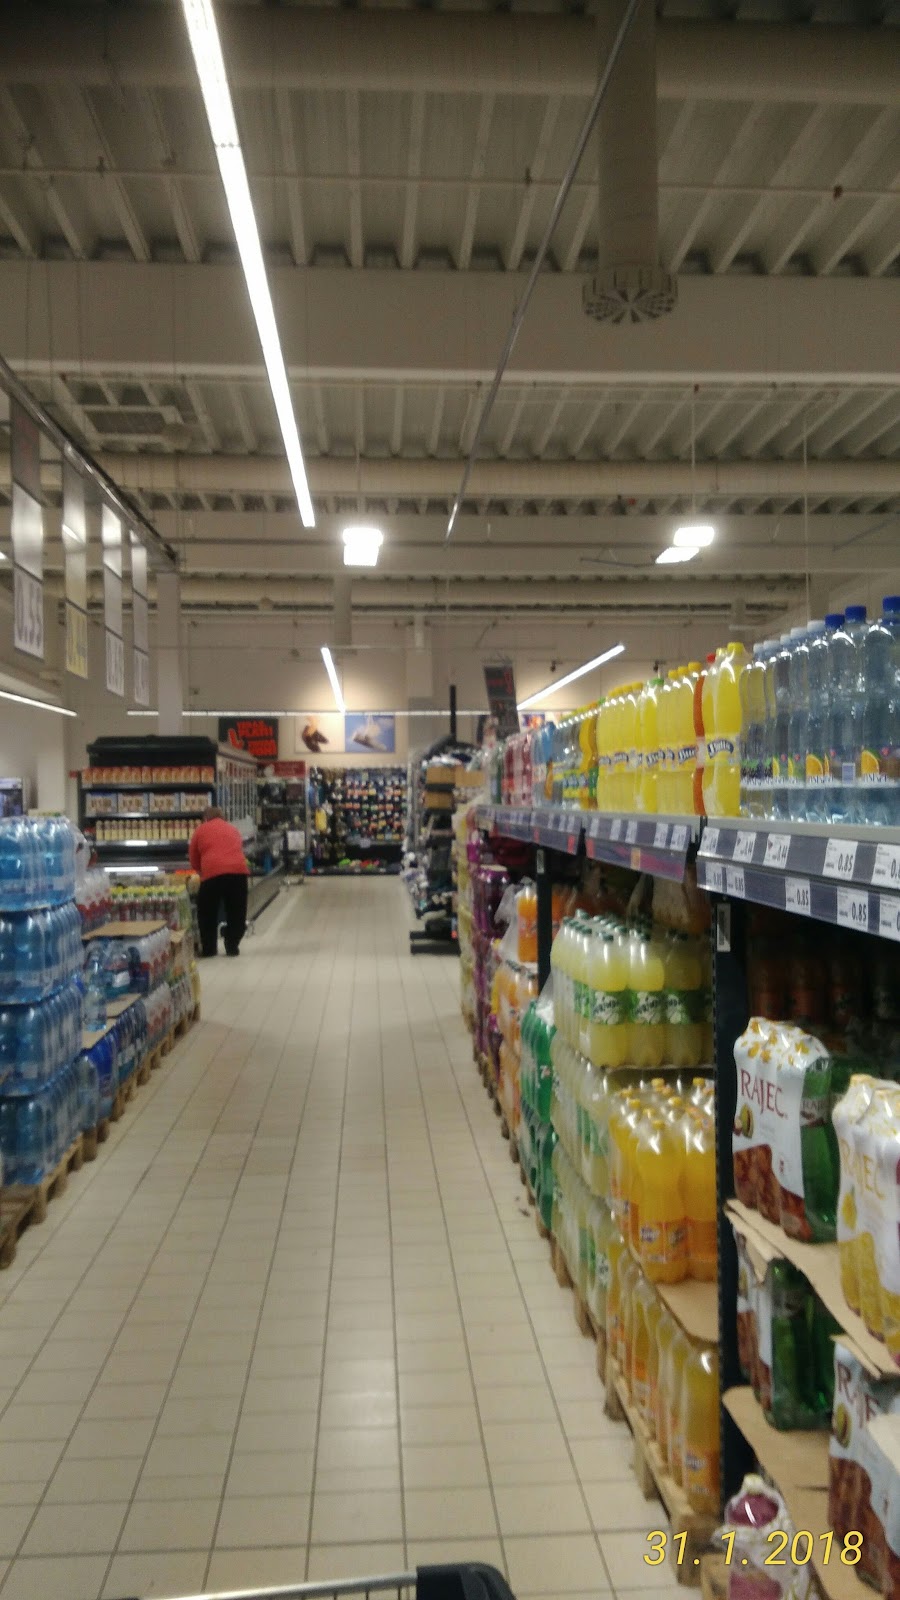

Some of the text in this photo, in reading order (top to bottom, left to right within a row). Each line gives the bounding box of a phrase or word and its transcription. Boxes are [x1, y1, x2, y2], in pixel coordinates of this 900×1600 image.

[837, 853, 854, 872] 0.85
[796, 889, 809, 906] 0.85
[851, 902, 867, 921] 0.85
[741, 1068, 785, 1118] RAJEC
